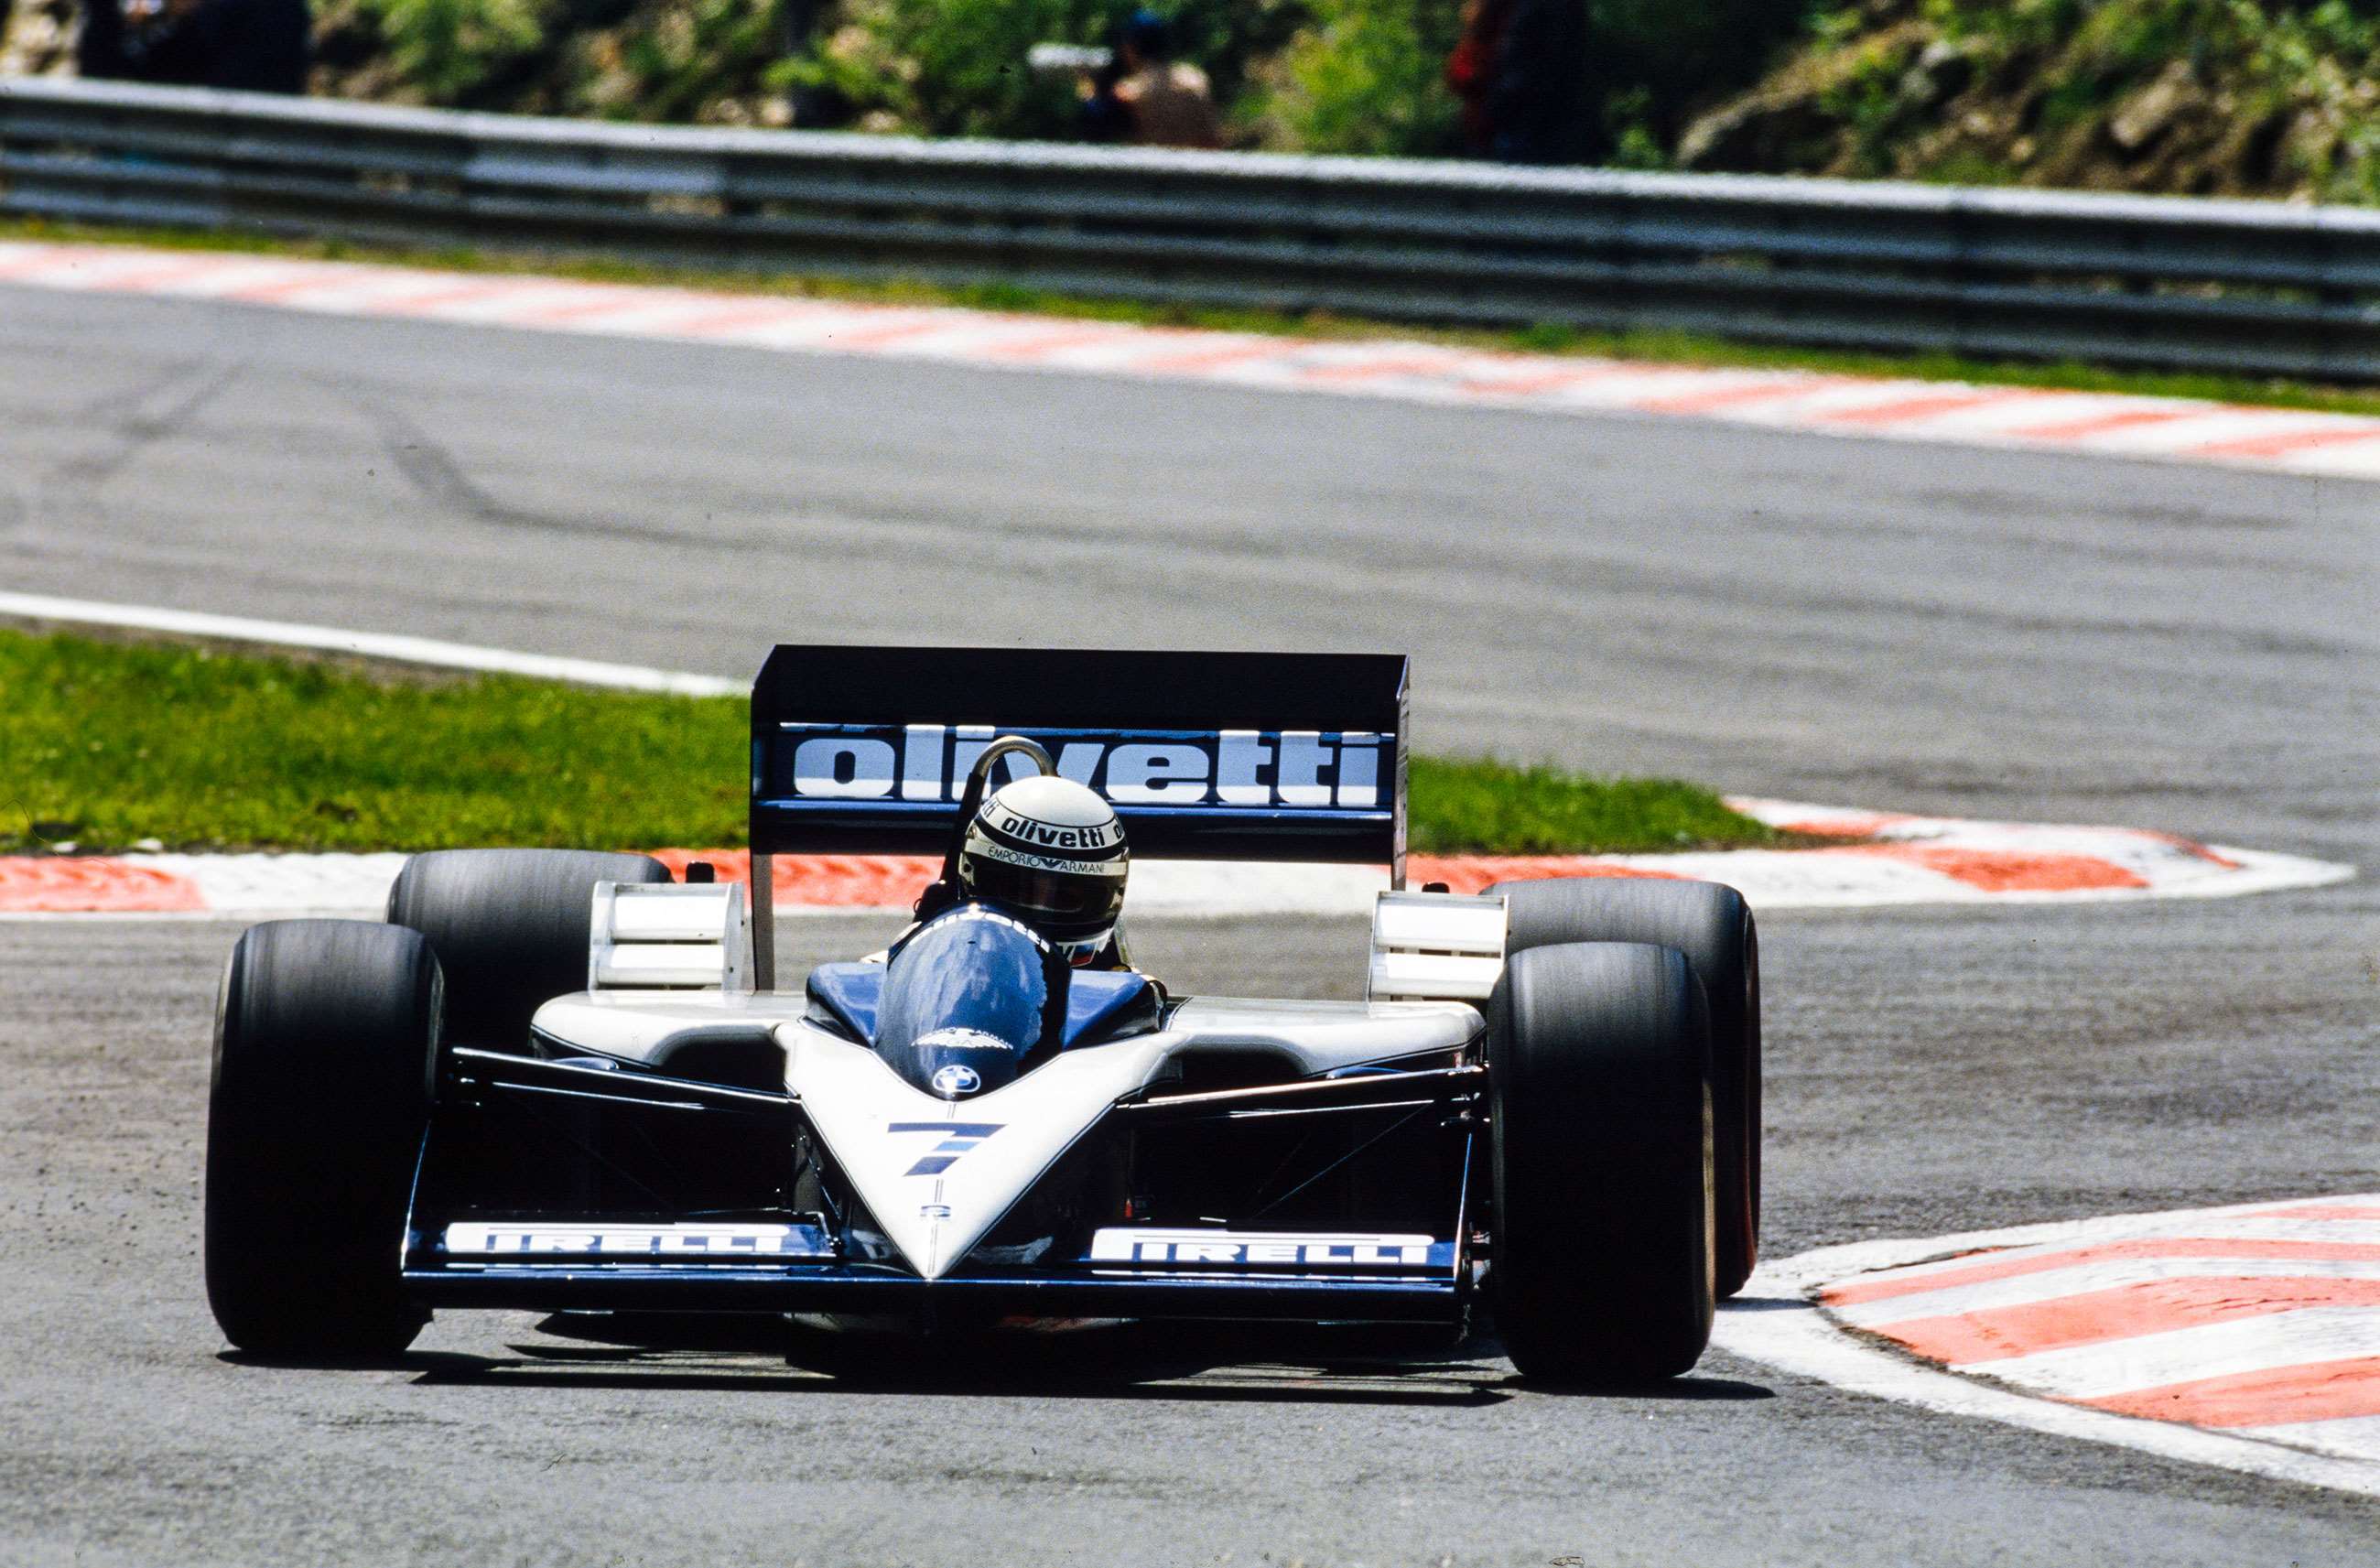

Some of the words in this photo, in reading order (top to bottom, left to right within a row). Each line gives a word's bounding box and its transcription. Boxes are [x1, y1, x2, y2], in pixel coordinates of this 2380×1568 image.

[794, 723, 1379, 806] olivetti
[1001, 817, 1106, 848] olivetti
[988, 846, 1041, 868] EMPORIO
[887, 1122, 1008, 1177] 7
[446, 1222, 790, 1253] PIRELLI
[1090, 1227, 1435, 1264] PIRELLI
